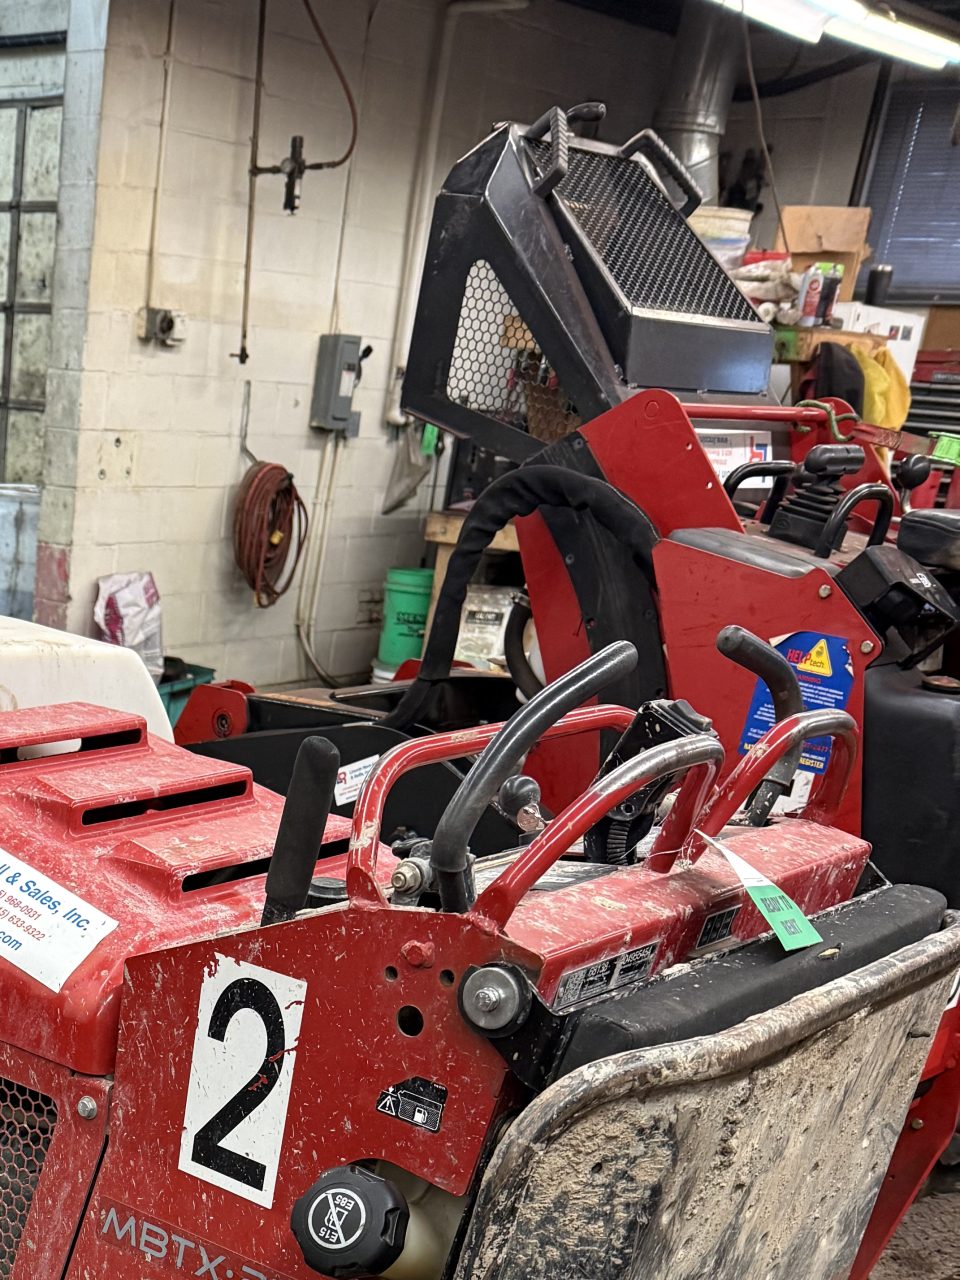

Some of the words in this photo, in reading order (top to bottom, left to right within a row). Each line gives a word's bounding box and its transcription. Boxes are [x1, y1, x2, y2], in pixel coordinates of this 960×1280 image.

[5, 872, 22, 885] &
[20, 880, 61, 915] Sales,
[62, 907, 90, 931] Inc.
[5, 895, 42, 920] 968-0931
[7, 914, 46, 941] 633-9322
[191, 976, 286, 1192] 2
[334, 1194, 355, 1211] E85
[318, 1226, 339, 1243] E15
